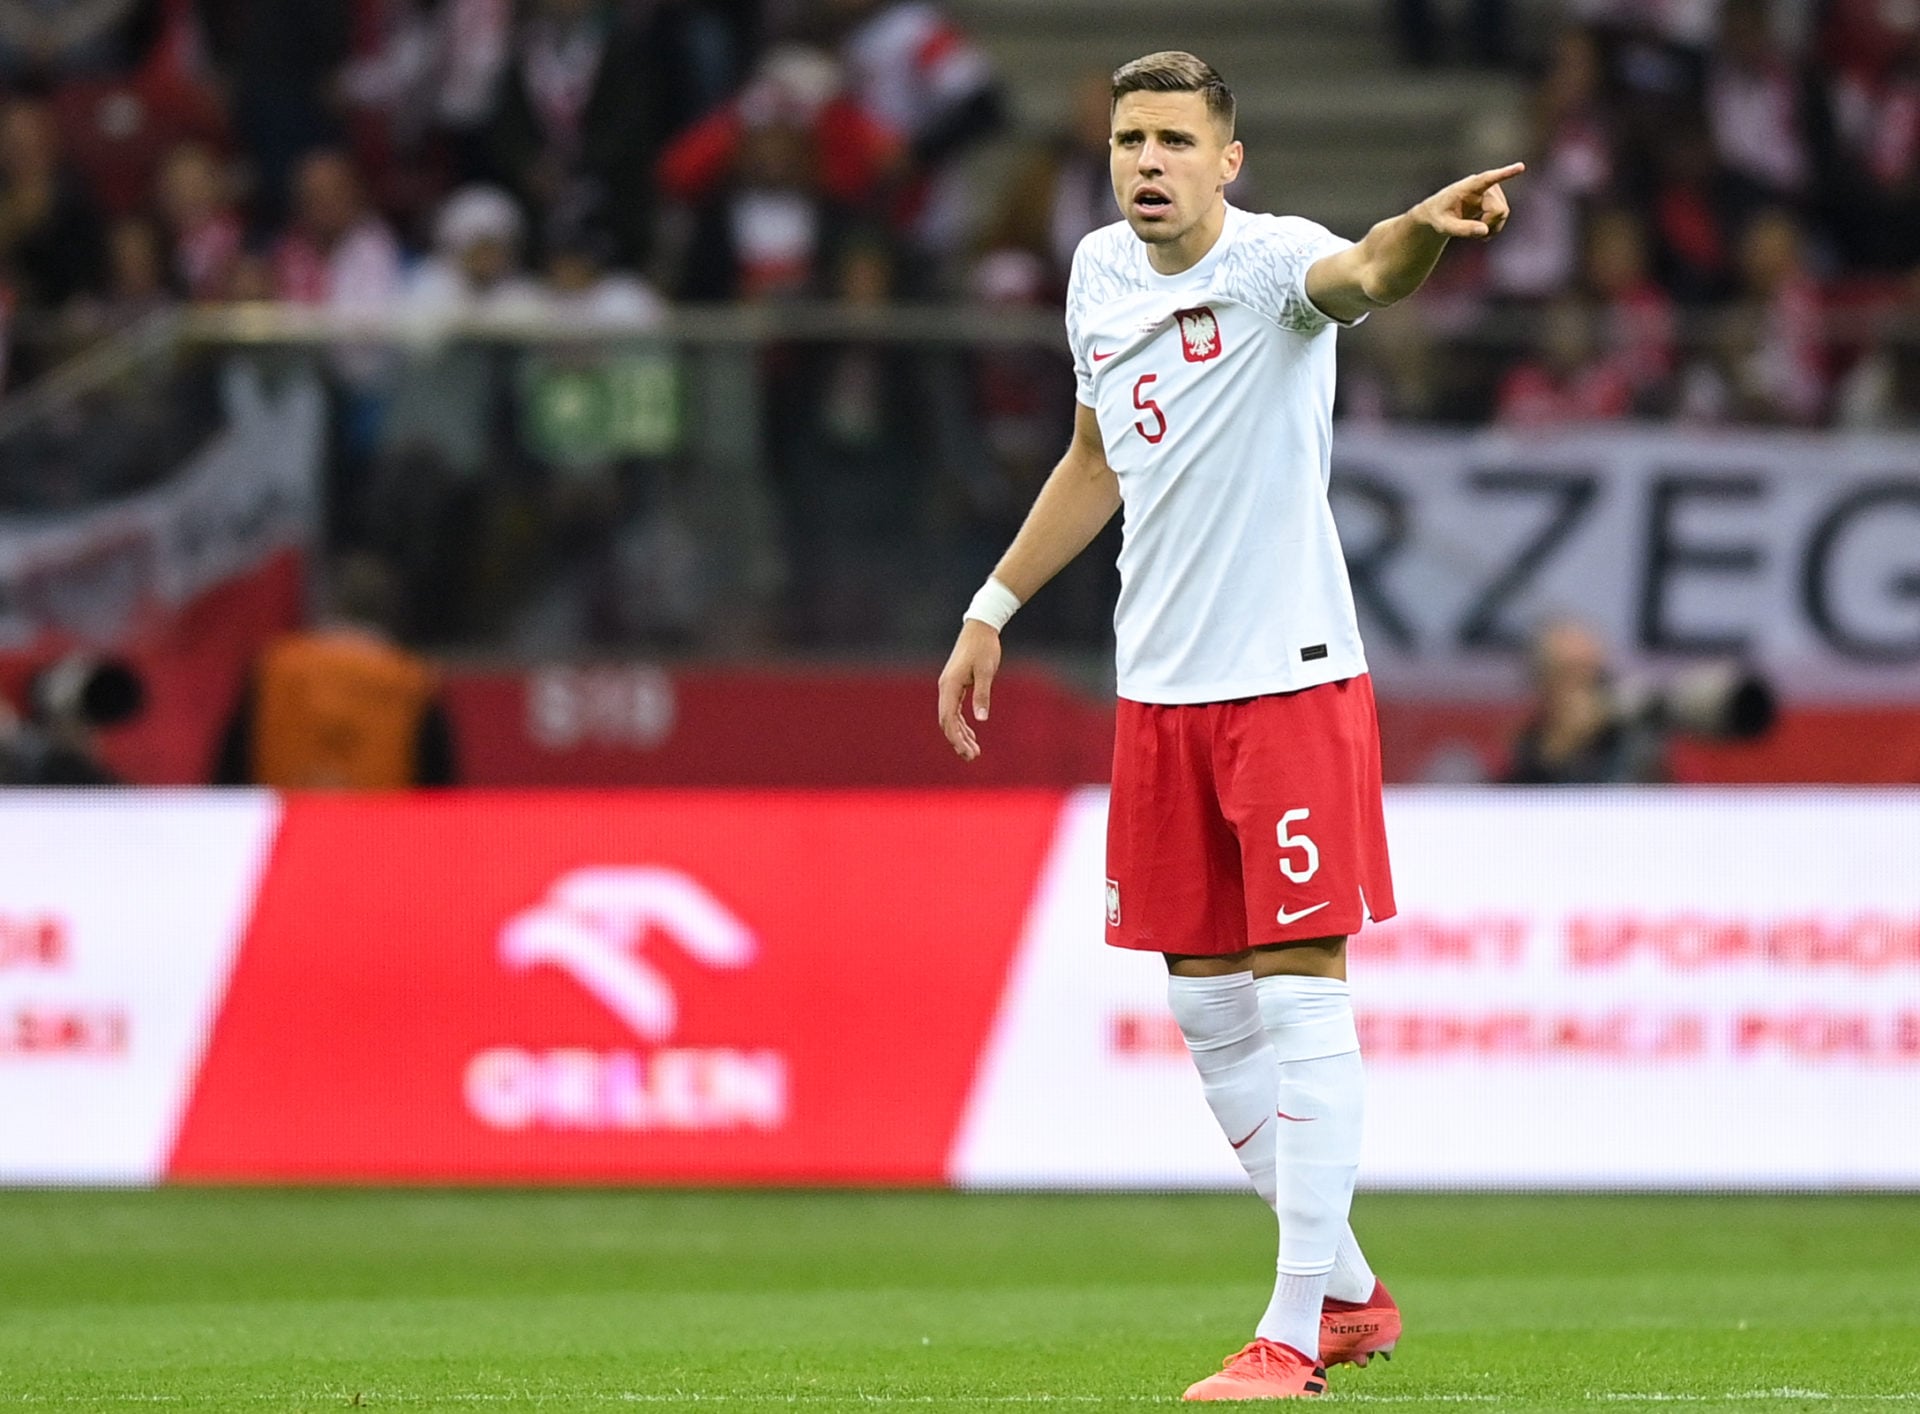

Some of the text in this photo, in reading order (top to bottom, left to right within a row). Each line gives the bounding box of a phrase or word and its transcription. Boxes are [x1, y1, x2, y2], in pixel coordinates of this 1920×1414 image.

[1133, 373, 1167, 443] 5
[1276, 807, 1319, 884] 5
[463, 1047, 788, 1130] ORLEN
[1330, 1323, 1379, 1334] NEMESIS
